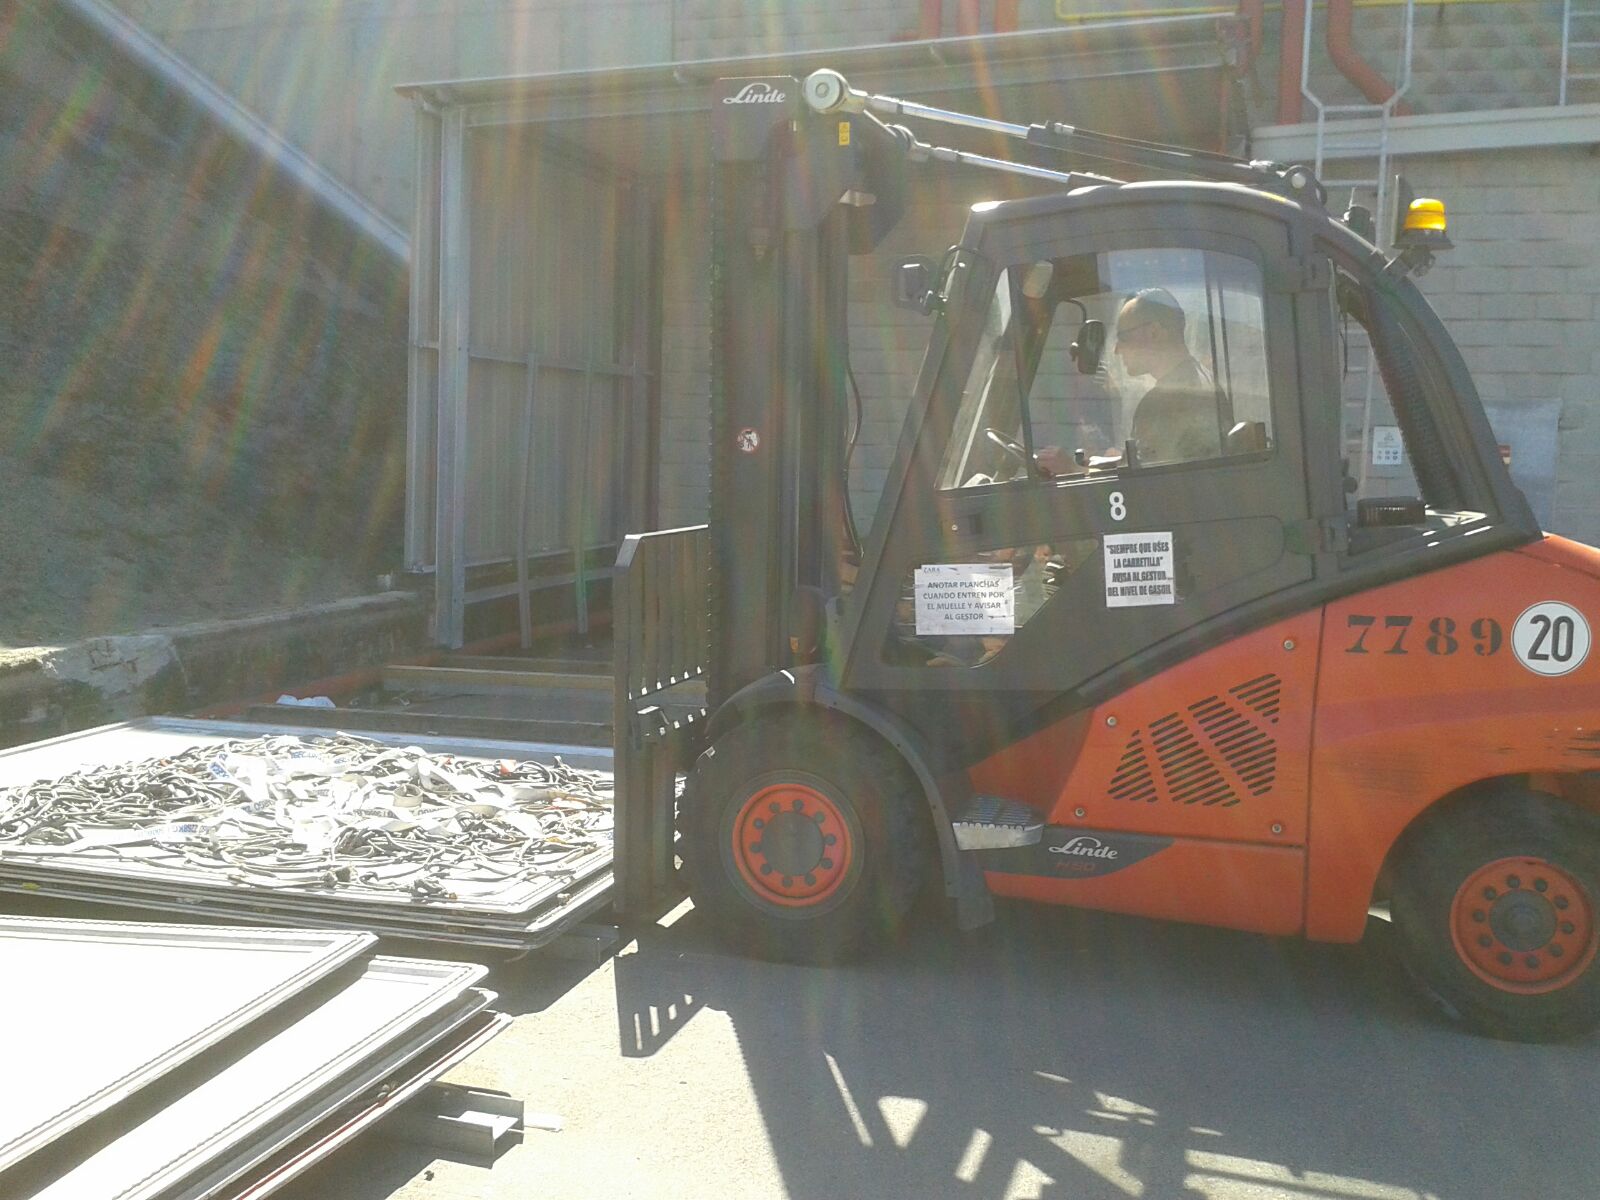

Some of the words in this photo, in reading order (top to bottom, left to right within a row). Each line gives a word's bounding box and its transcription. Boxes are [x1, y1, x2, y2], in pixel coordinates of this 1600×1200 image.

[723, 82, 786, 104] Linde
[1109, 491, 1127, 521] 8
[1139, 542, 1152, 553] QUE
[1113, 558, 1121, 568] LA
[1112, 572, 1131, 583] AVISA
[1132, 571, 1141, 581] AL
[927, 581, 958, 589] ANOTAR
[959, 580, 1000, 588] PLANCHAS
[957, 591, 987, 599] ENTREN
[1107, 587, 1119, 597] DEL
[1120, 586, 1138, 596] NIVEL
[1139, 585, 1148, 596] DE
[1345, 615, 1503, 656] 7789
[1527, 614, 1575, 662] 20
[1048, 836, 1118, 859] Linde
